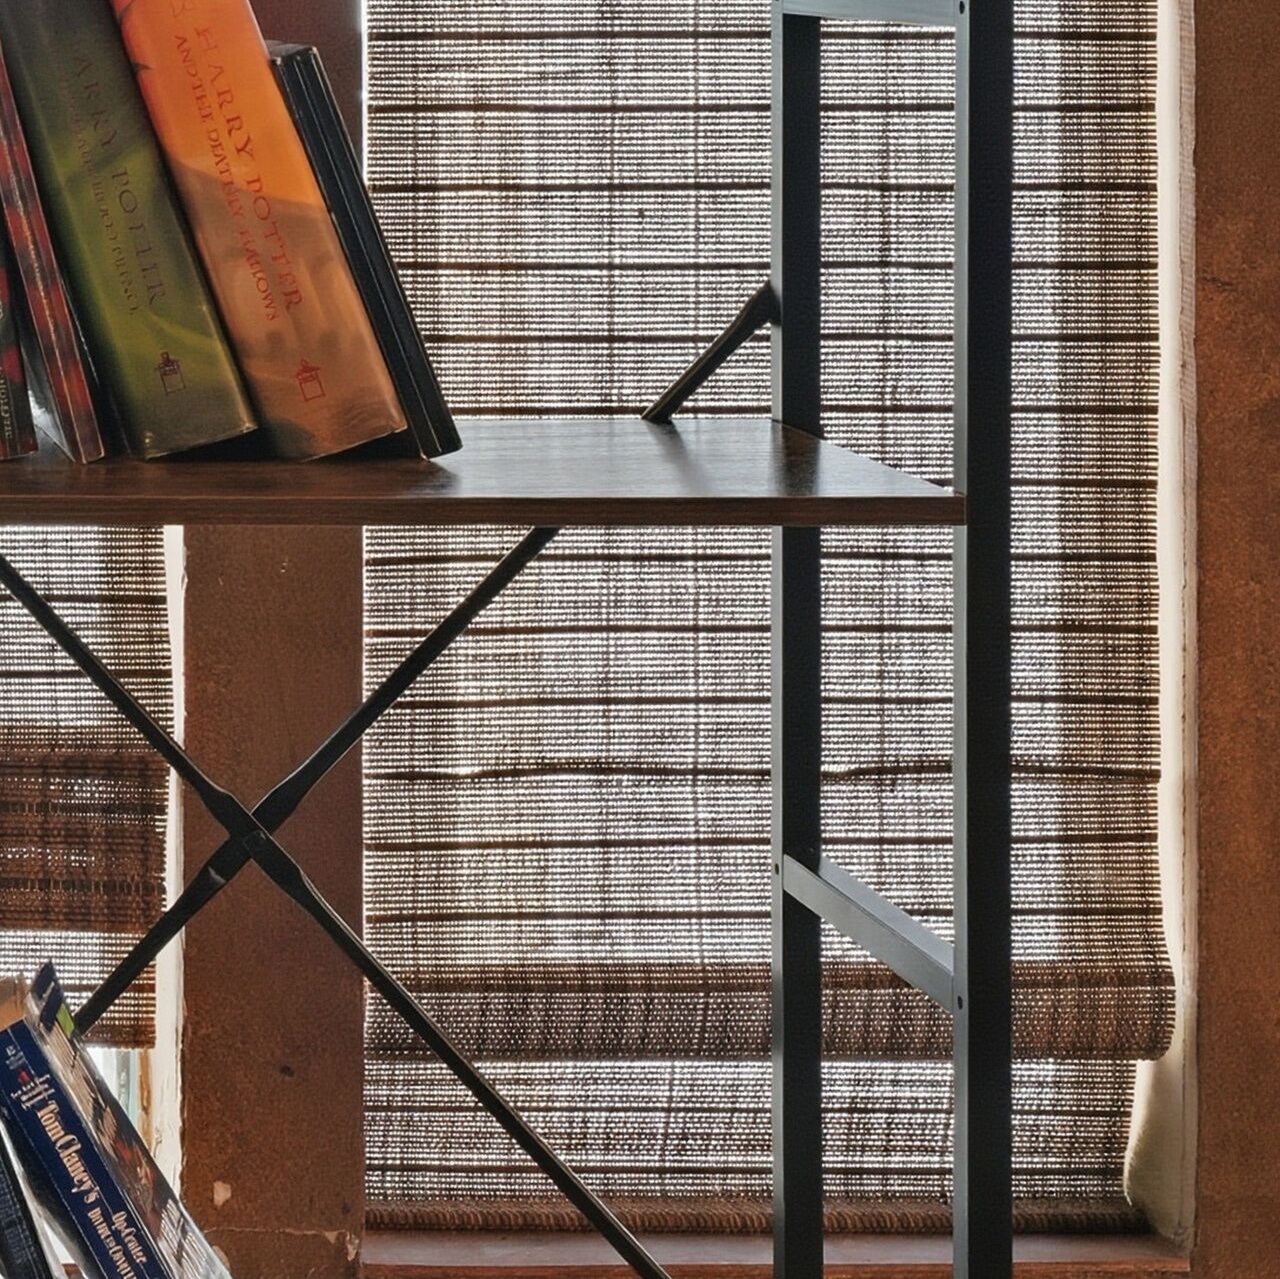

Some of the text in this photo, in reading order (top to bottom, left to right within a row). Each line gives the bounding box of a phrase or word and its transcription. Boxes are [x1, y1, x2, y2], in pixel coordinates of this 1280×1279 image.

[174, 34, 199, 78] AND
[191, 79, 216, 125] THE
[207, 128, 246, 221] DEATHLY
[196, 25, 303, 313] HARRY POTTER
[35, 1097, 101, 1206] Tom Clancy's
